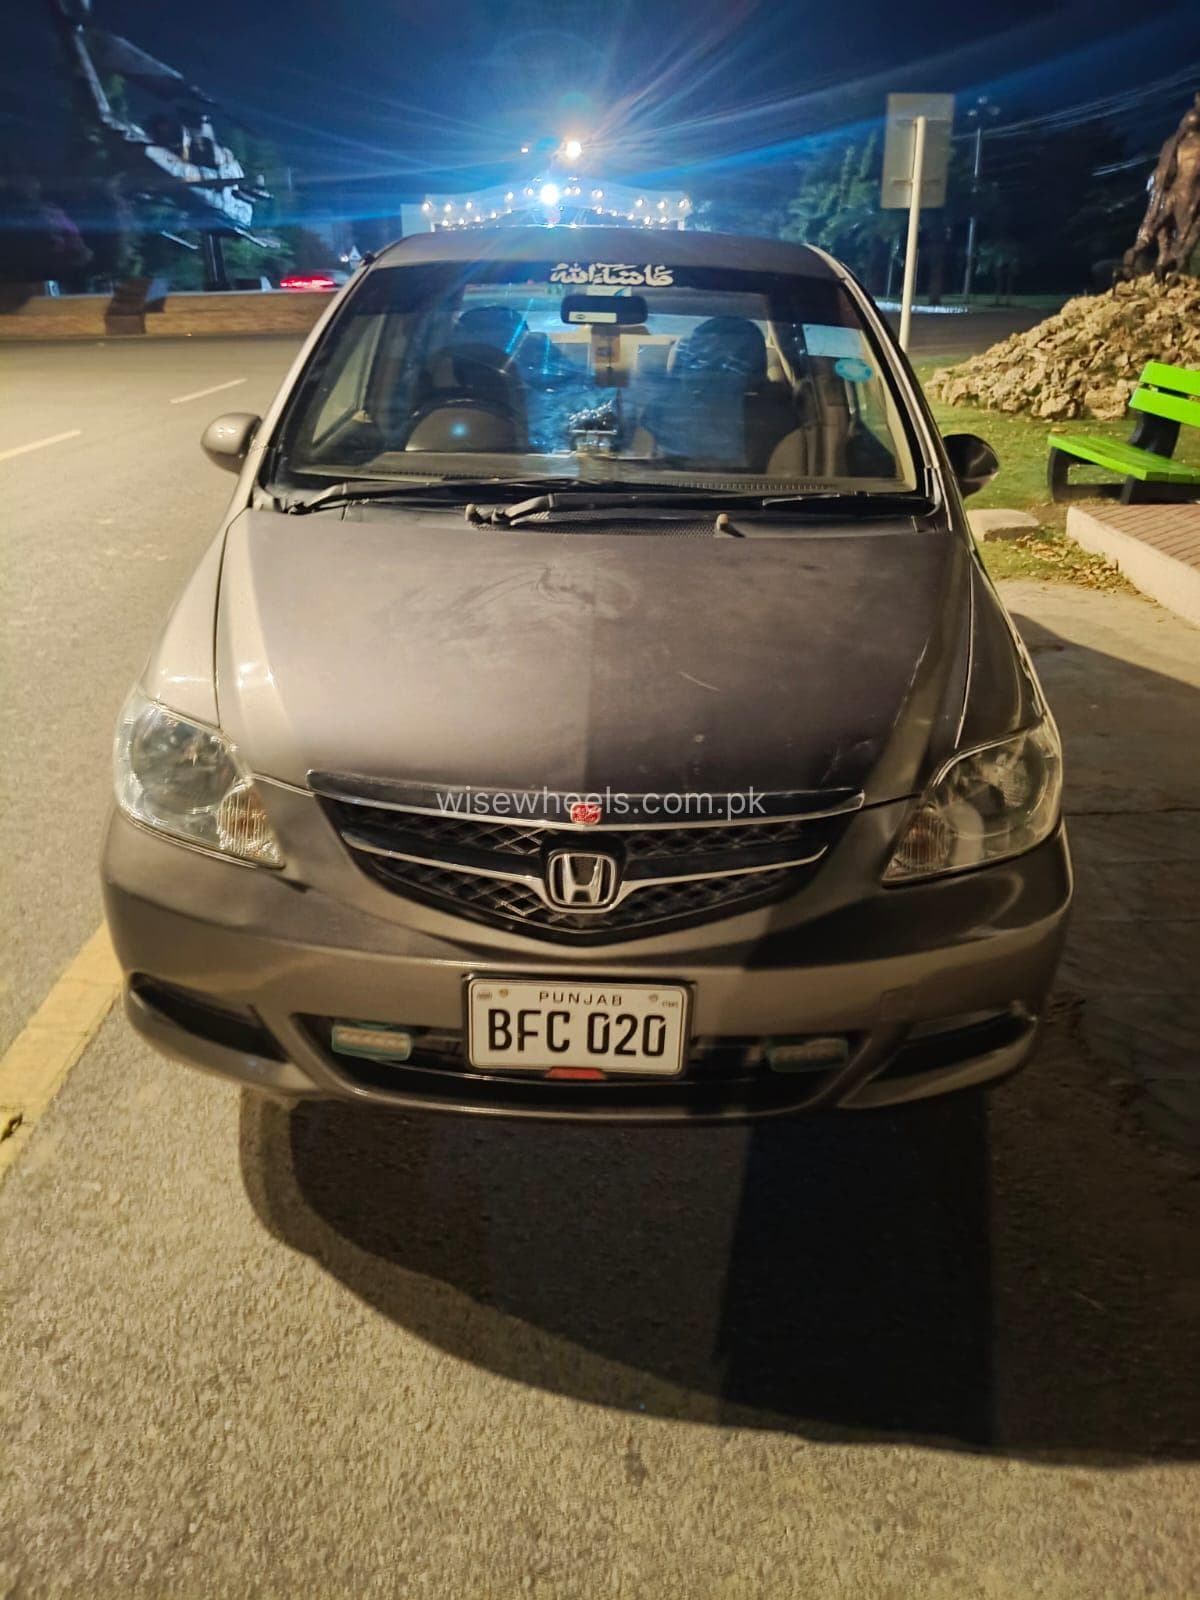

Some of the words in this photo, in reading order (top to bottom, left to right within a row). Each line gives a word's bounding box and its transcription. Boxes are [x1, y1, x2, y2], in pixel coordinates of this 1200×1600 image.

[539, 991, 623, 1006] PUNJAB
[488, 1009, 571, 1052] BFC
[586, 1012, 667, 1056] 020
